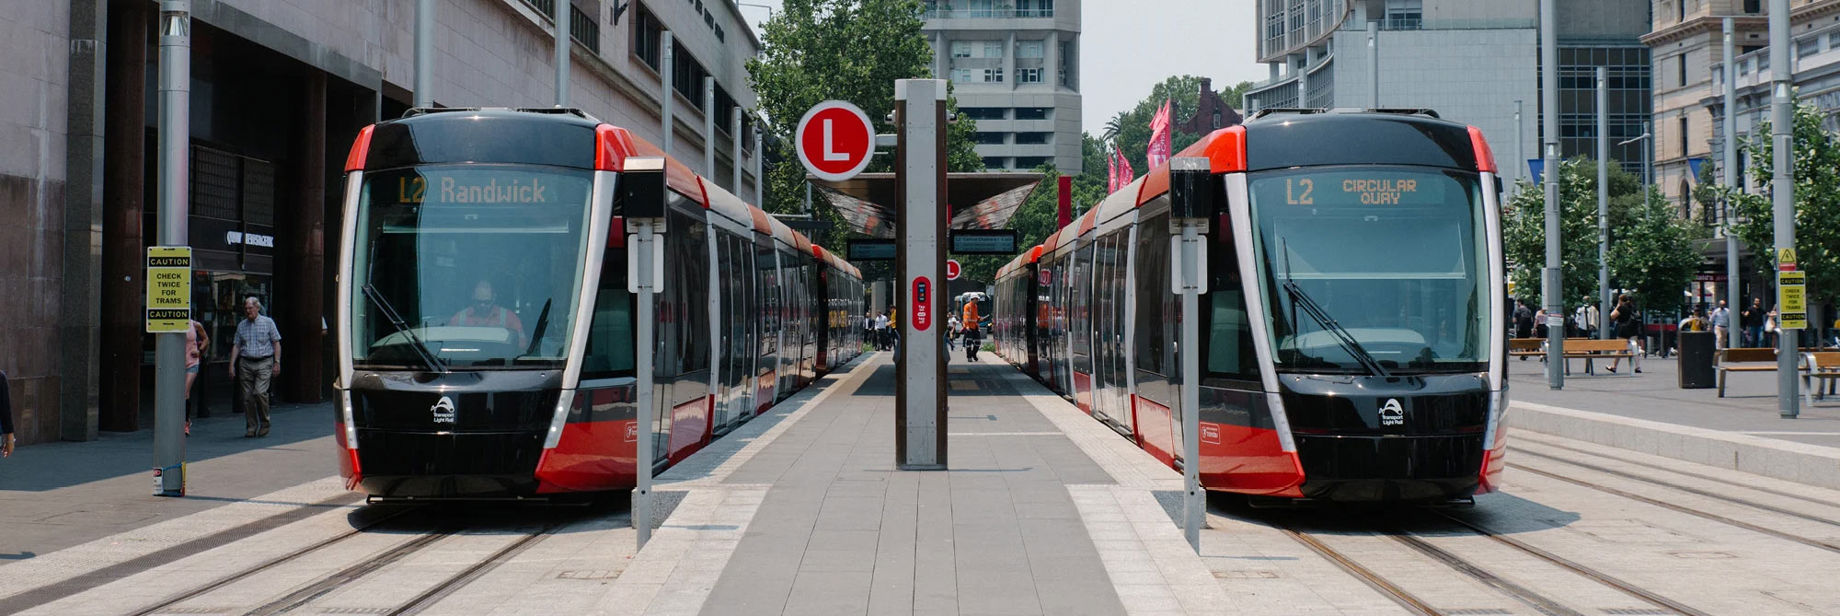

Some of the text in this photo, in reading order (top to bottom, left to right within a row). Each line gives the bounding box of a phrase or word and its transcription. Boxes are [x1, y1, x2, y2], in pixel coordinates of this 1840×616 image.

[823, 118, 850, 161] L
[400, 176, 545, 203] L2 Randwick
[1286, 178, 1417, 205] L2 CIRCULAR
[1361, 192, 1400, 205] QUAY
[946, 263, 955, 276] L
